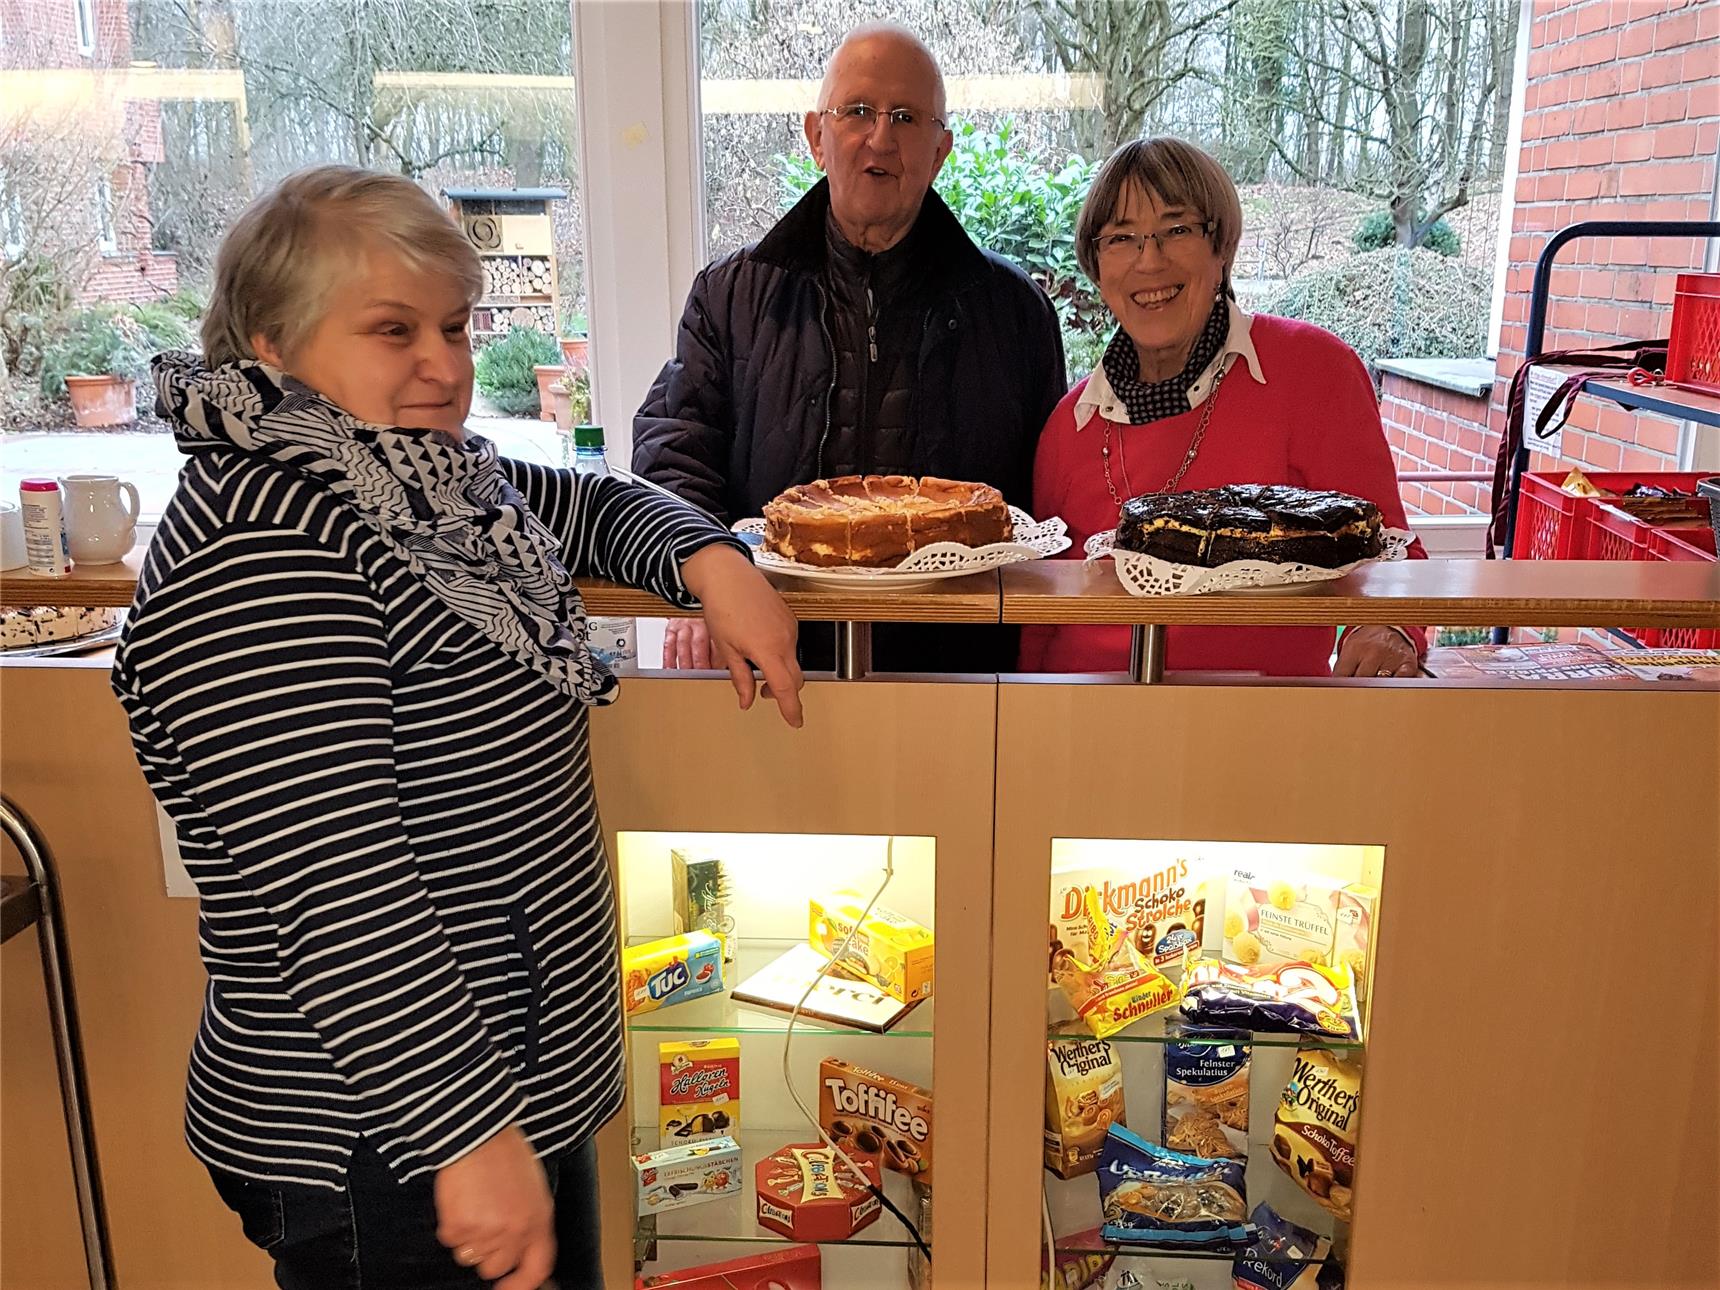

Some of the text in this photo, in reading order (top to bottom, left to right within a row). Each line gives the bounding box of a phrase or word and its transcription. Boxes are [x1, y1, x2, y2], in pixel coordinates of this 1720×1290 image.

[1125, 898, 1192, 932] Strolche
[1135, 886, 1185, 914] Schoko
[1260, 908, 1292, 926] FEINSTE
[1294, 917, 1329, 937] TRÜFFEL
[651, 966, 686, 998] TUC
[1113, 988, 1173, 1023] Schnuller
[1176, 1067, 1229, 1078] Spekulatius
[1199, 1060, 1237, 1068] Feinster
[1292, 1057, 1360, 1113] Werther's
[825, 1078, 930, 1142] Toffifee
[1296, 1085, 1352, 1132] Original
